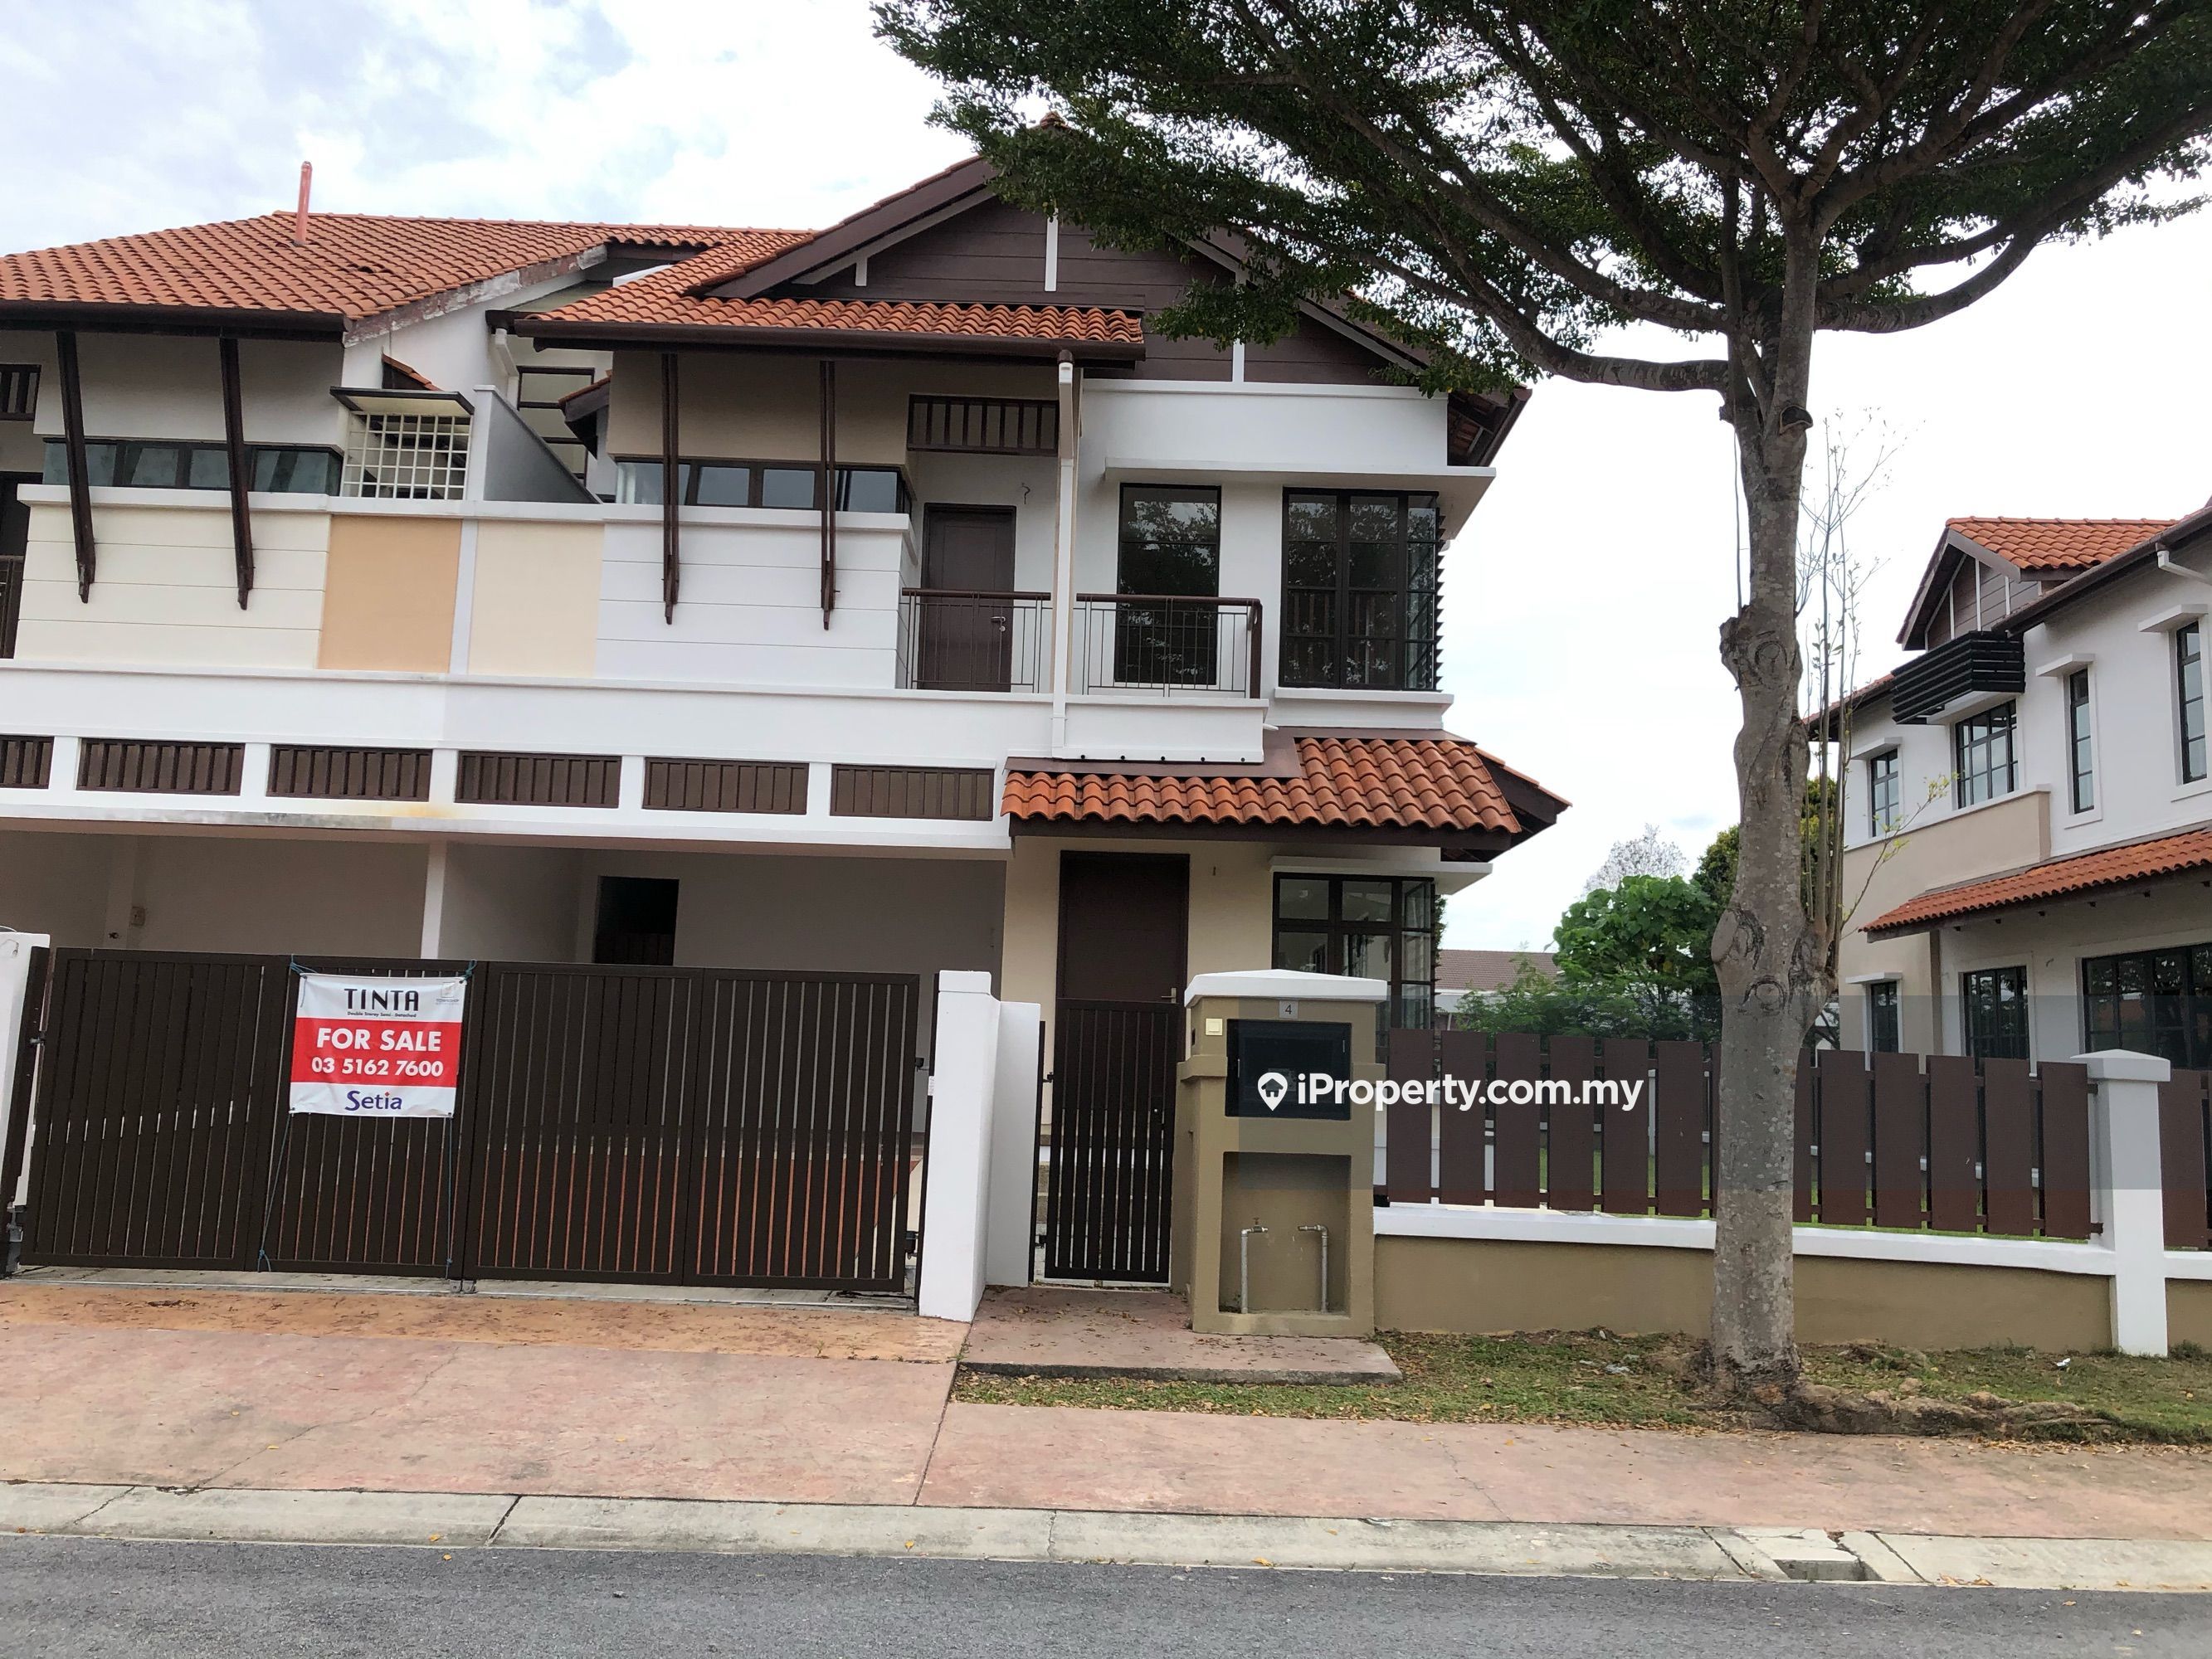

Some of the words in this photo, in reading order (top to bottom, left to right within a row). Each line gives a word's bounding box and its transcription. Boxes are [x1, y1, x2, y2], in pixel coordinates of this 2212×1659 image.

[344, 988, 419, 1011] TINTA
[1284, 1004, 1293, 1014] 4
[316, 1028, 371, 1050] FOR
[379, 1029, 441, 1052] SALE
[311, 1057, 335, 1074] 03
[341, 1058, 389, 1076] 5162
[394, 1060, 444, 1077] 7600
[344, 1090, 402, 1112] Setia
